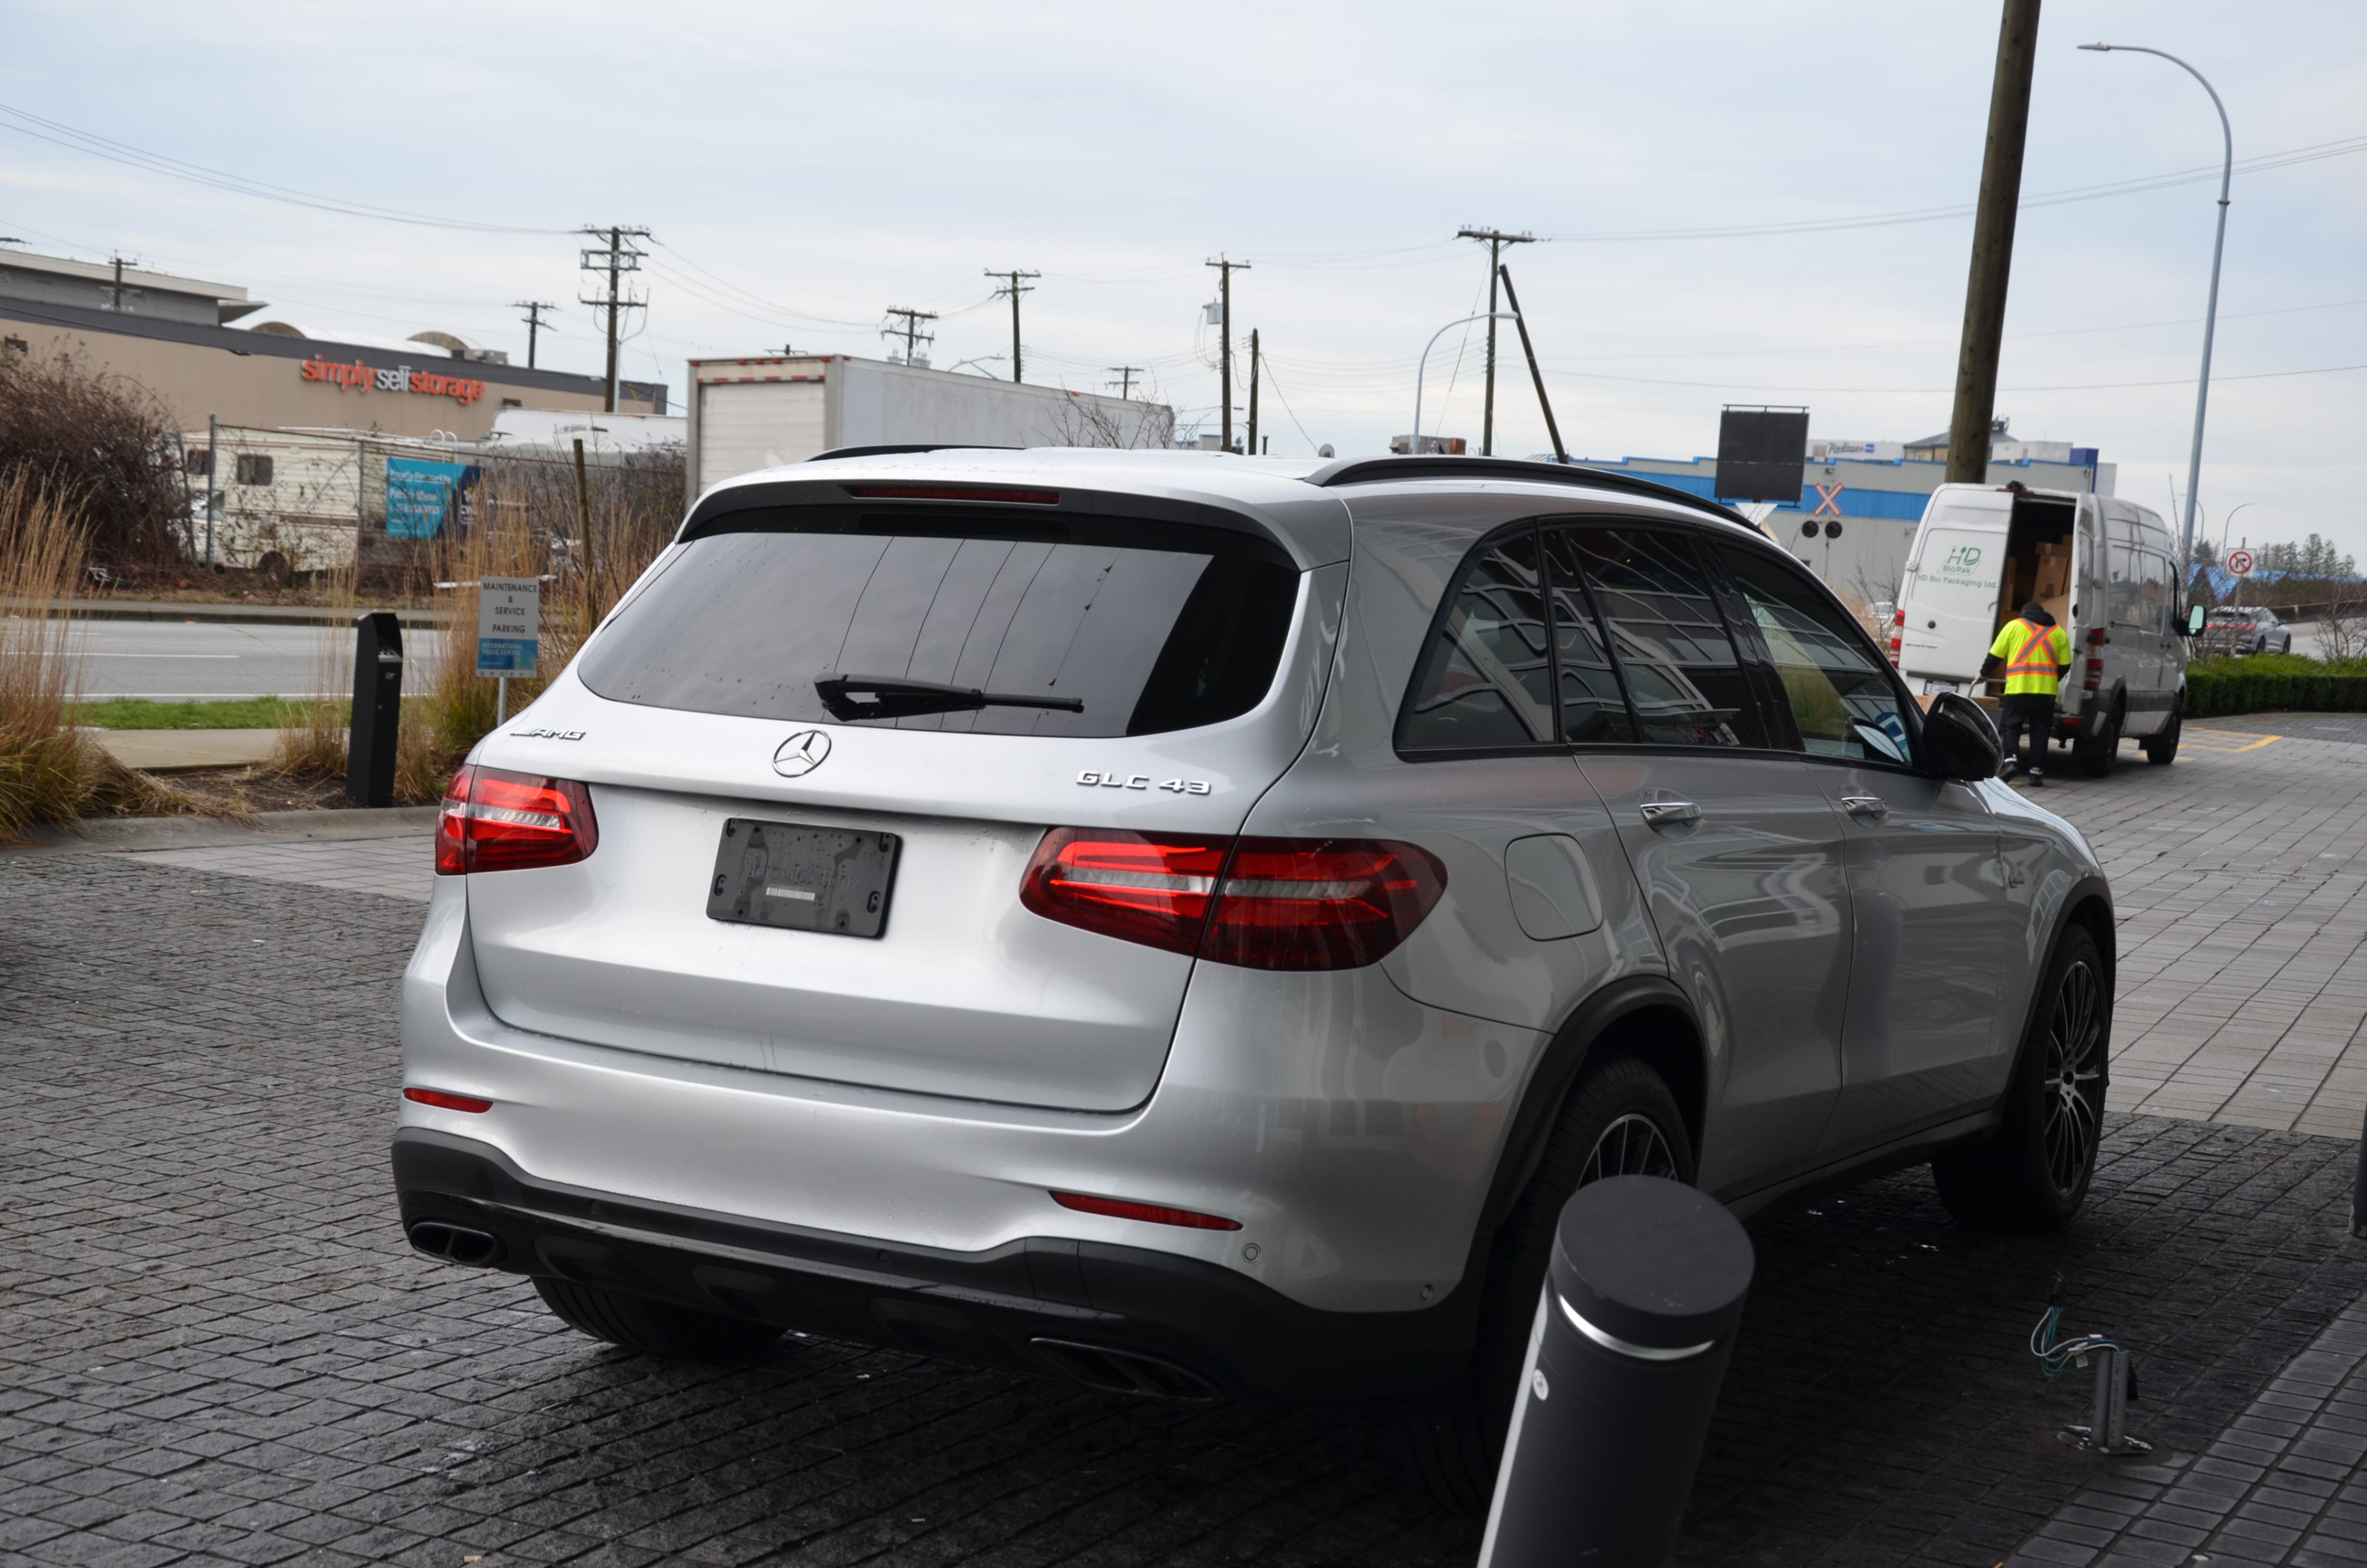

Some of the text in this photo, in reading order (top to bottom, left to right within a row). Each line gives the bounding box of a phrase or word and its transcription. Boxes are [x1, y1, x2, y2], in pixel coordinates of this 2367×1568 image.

[302, 354, 485, 405] simply self storage
[1947, 545, 1981, 565] HD
[483, 582, 537, 592] MAINTENANCE
[1943, 576, 1982, 588] Packaging
[495, 607, 525, 616] SERVICE
[492, 624, 525, 633] PARKING
[530, 728, 585, 741] AMG
[1076, 770, 1212, 796] GLC 43
